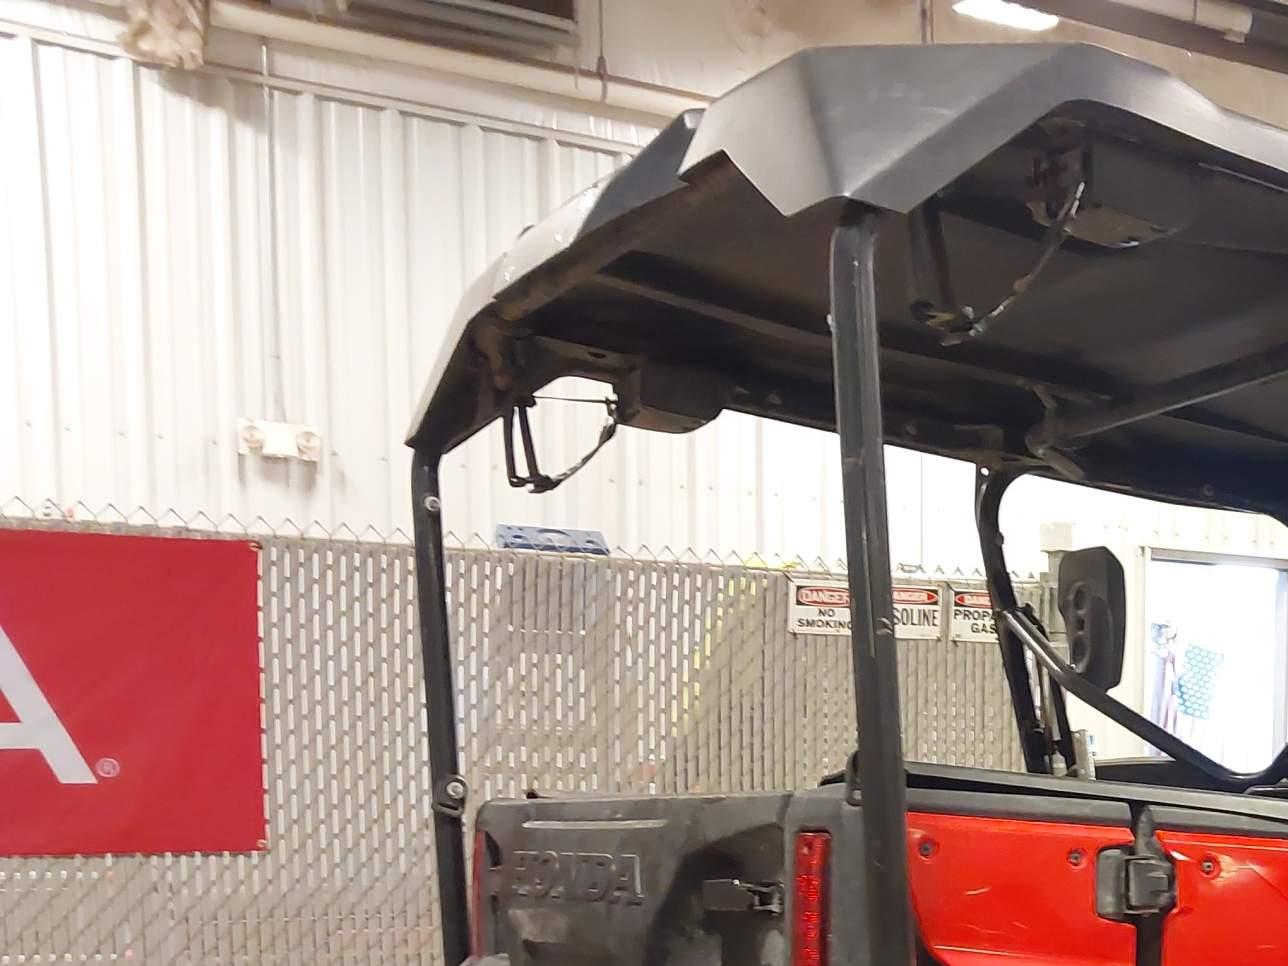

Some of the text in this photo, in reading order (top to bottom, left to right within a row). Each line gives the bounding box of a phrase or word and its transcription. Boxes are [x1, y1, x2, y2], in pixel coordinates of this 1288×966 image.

[893, 591, 927, 602] ANGER
[818, 608, 836, 618] NO
[893, 608, 939, 627] SOLINE
[954, 609, 992, 621] PROP
[797, 618, 853, 630] SMOKING
[971, 622, 998, 634] GAS
[512, 850, 645, 905] HONDA
